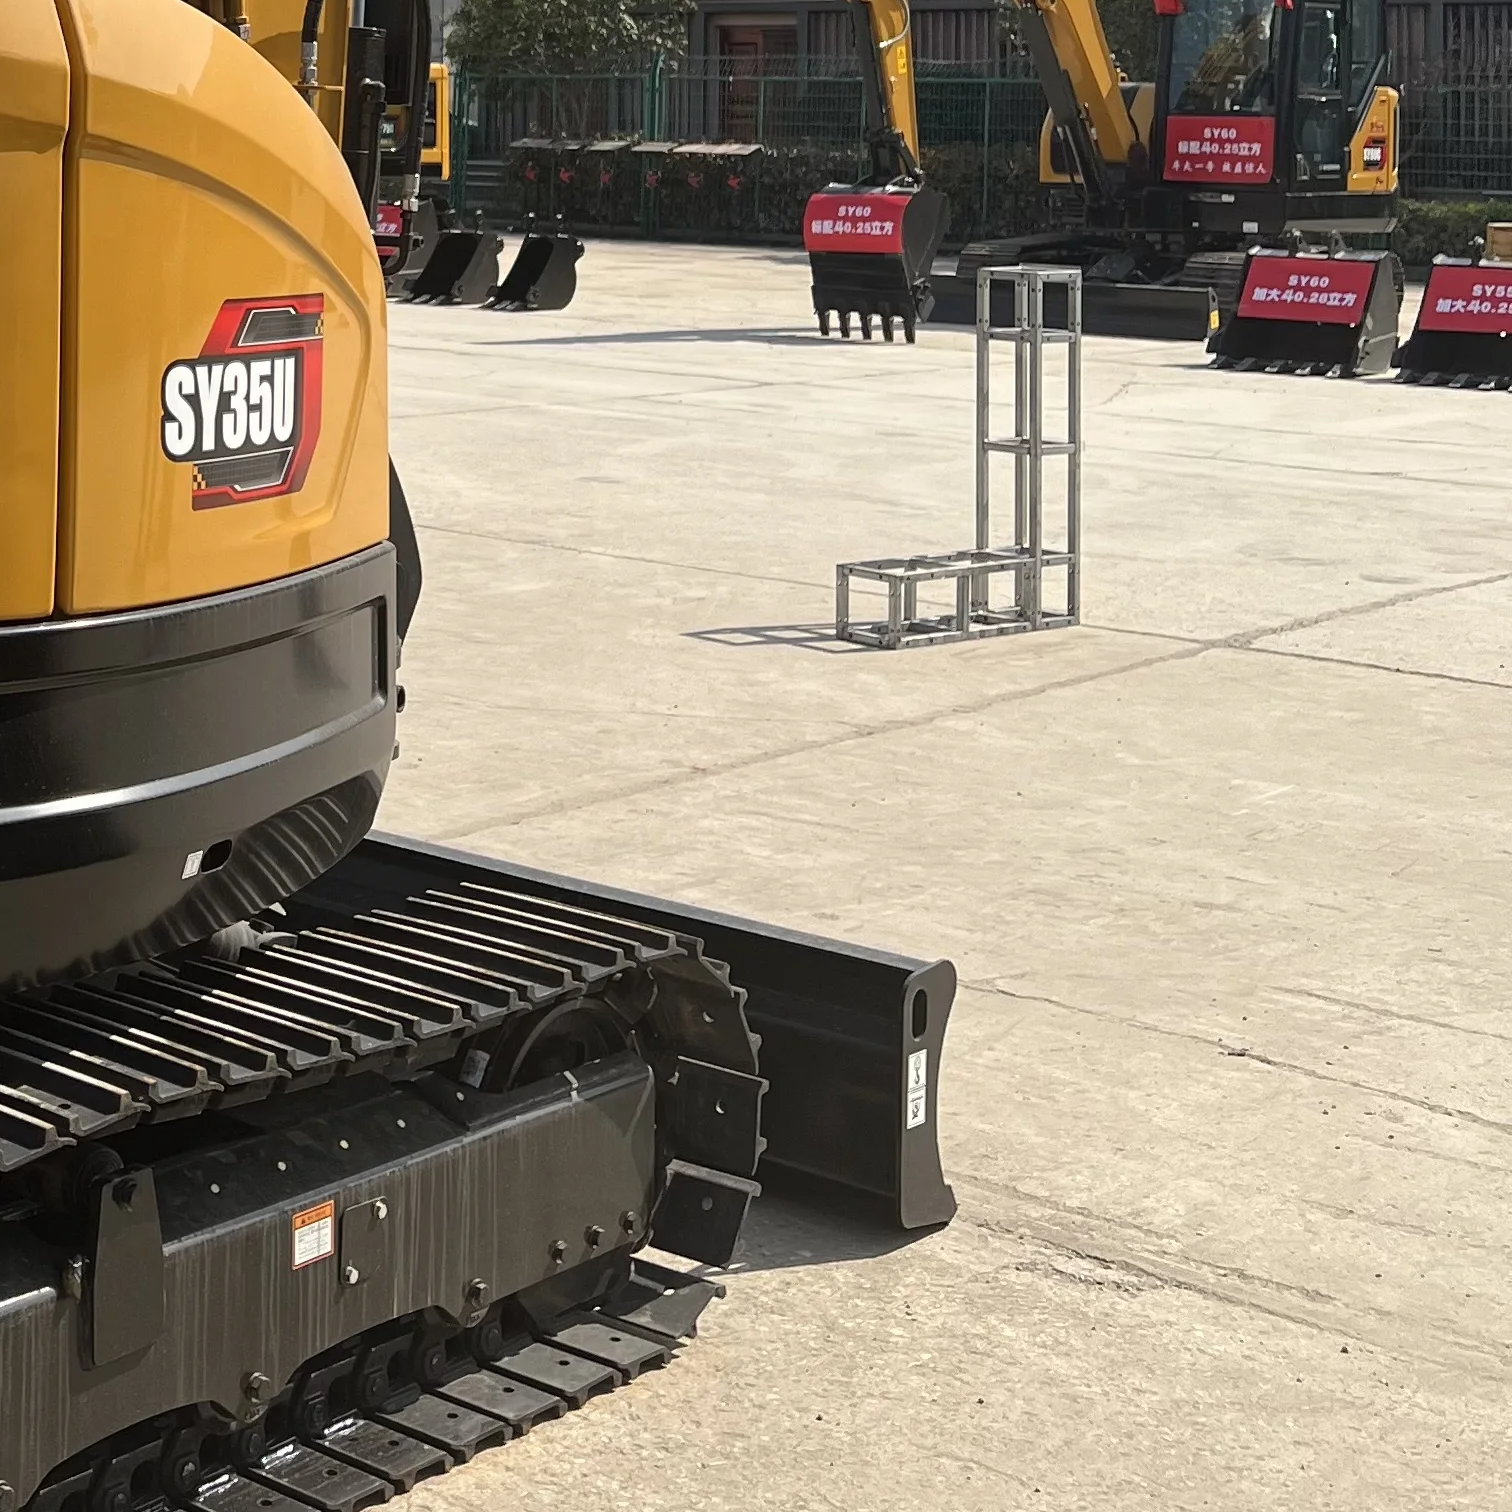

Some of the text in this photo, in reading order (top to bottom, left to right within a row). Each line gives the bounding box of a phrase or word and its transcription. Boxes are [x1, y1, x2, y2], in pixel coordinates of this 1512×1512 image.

[1203, 127, 1237, 140] SY60
[837, 205, 872, 217] SY60
[1288, 274, 1330, 288] SY60
[164, 356, 296, 456] SY35U
